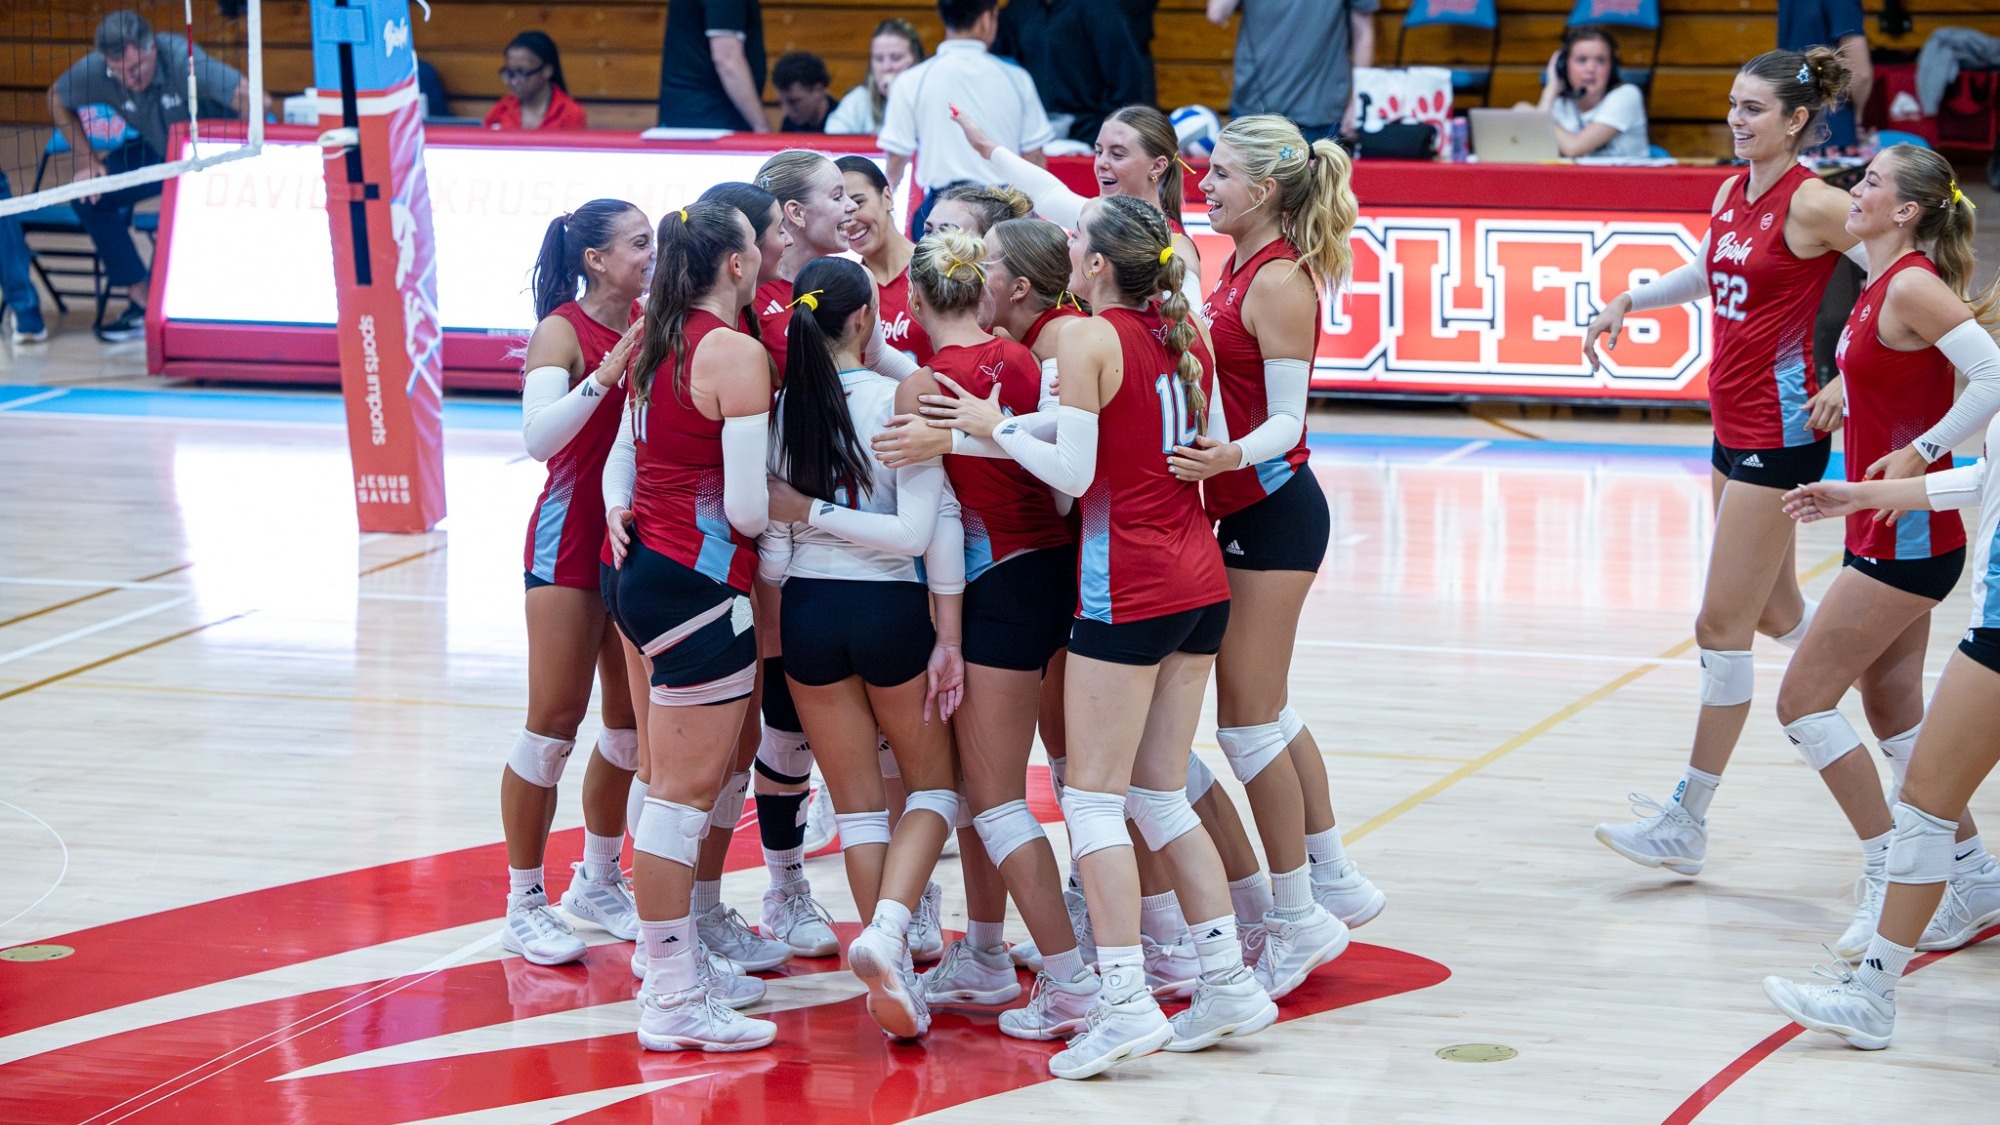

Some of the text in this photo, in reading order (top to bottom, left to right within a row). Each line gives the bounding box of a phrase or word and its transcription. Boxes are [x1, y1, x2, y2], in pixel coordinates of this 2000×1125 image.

[1712, 231, 1753, 266] Biola
[1711, 271, 1749, 322] 22
[358, 314, 388, 446] sports imports
[357, 474, 410, 490] JESUS
[357, 488, 411, 504] SAVES
